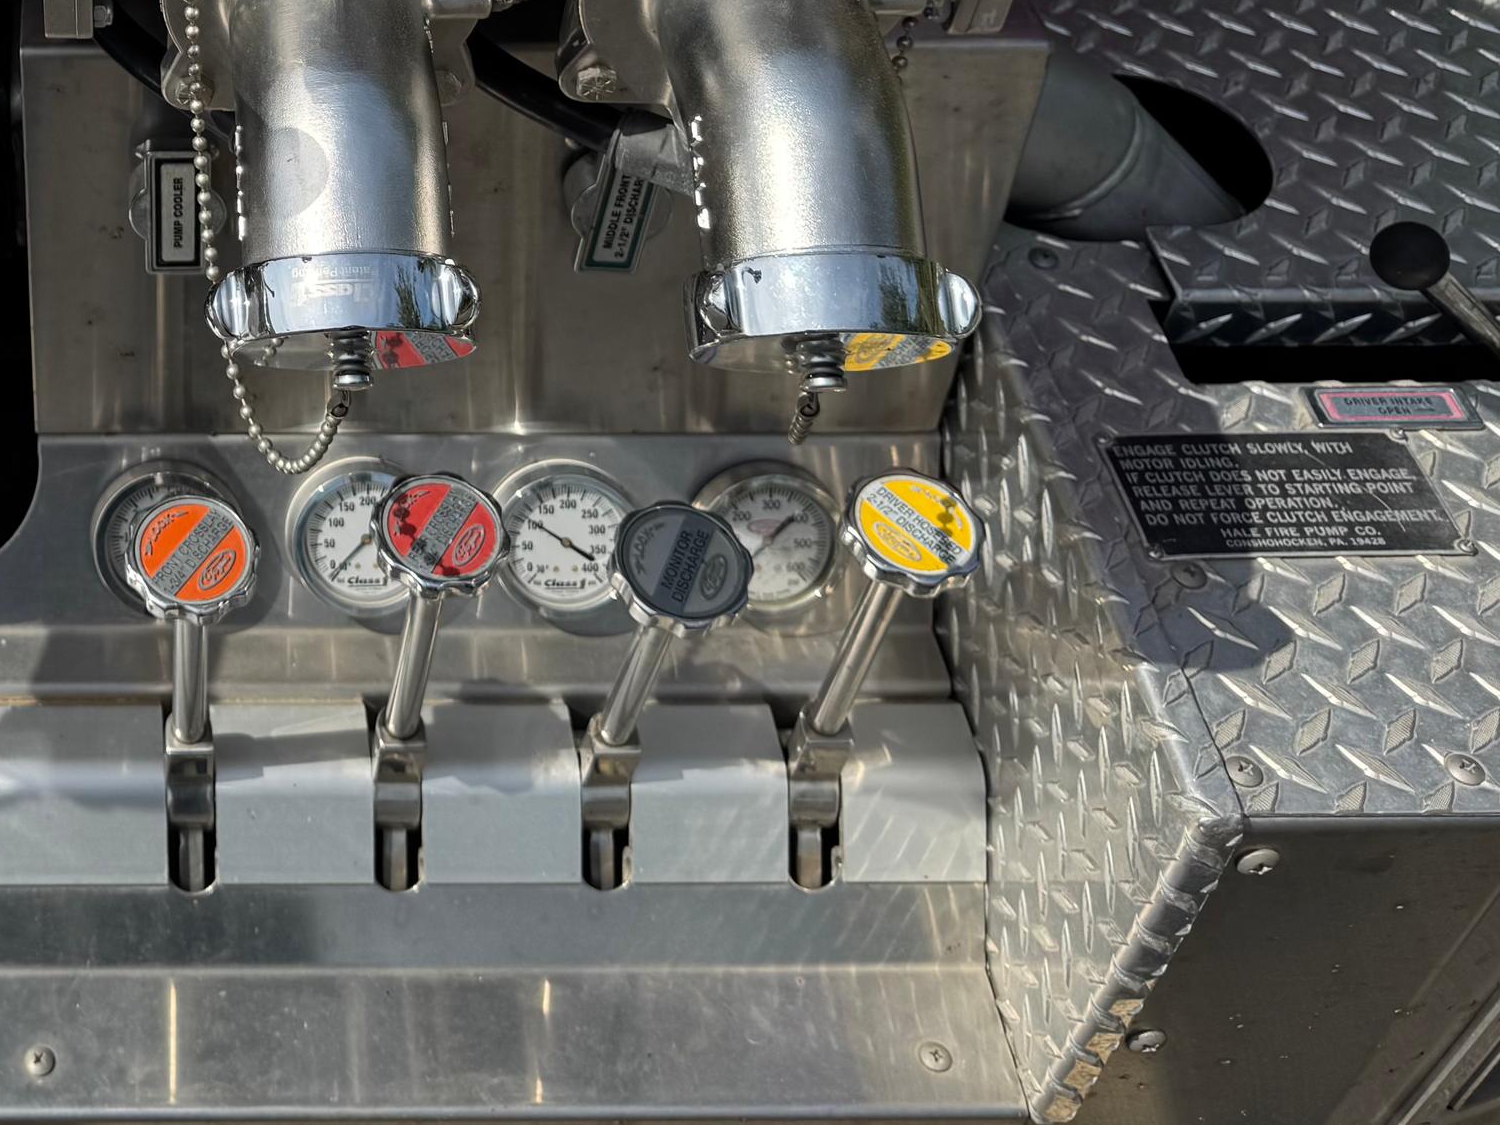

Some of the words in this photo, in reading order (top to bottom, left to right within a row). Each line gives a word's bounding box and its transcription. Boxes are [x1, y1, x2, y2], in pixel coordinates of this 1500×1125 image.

[173, 178, 182, 217] COOLER
[603, 208, 621, 249] MIDDLE
[615, 176, 632, 209] FRONT
[174, 220, 182, 248] PUMP
[1344, 397, 1387, 406] DRIVER
[1390, 397, 1432, 405] INTAKE
[1113, 444, 1176, 457] ENGAGE
[1181, 443, 1241, 455] CLUTCH
[1246, 442, 1308, 455] SLOWLY,
[1312, 441, 1353, 454] WITH
[1119, 458, 1174, 470] MOTOR
[1181, 457, 1239, 468] IDLING.
[1125, 472, 1138, 483] IF
[1144, 471, 1205, 483] CLUTCH
[1211, 470, 1251, 482] DOES
[1256, 469, 1287, 481] NOT
[1292, 469, 1342, 480] EASILY
[1348, 468, 1417, 480] ENGAGE,
[1132, 485, 1201, 497] RELEASE
[1207, 484, 1253, 496] LEVER
[1258, 483, 1280, 495] TO
[1286, 483, 1365, 495] STARTING
[1366, 482, 1414, 493] POINT
[1140, 499, 1172, 511] AND
[1179, 499, 1237, 510] REPEAT
[1245, 497, 1338, 510] OPERATION.
[1146, 514, 1169, 525] DO
[1174, 512, 1205, 524] NOT
[1211, 511, 1263, 523] FORCE
[1266, 511, 1328, 523] CLUTCH
[179, 507, 218, 556] CROSSLAY
[876, 486, 914, 519] DRIVER
[913, 513, 962, 555] HOSEBED
[1220, 527, 1260, 538] HALE
[1265, 527, 1300, 537] FIRE
[1306, 526, 1349, 536] PUMP
[1355, 526, 1381, 535] CO.
[184, 517, 232, 569] DISCHARGE
[896, 517, 956, 563] DISCHARGE
[661, 530, 693, 590] MONITOR
[672, 530, 709, 603] DISCHARGE
